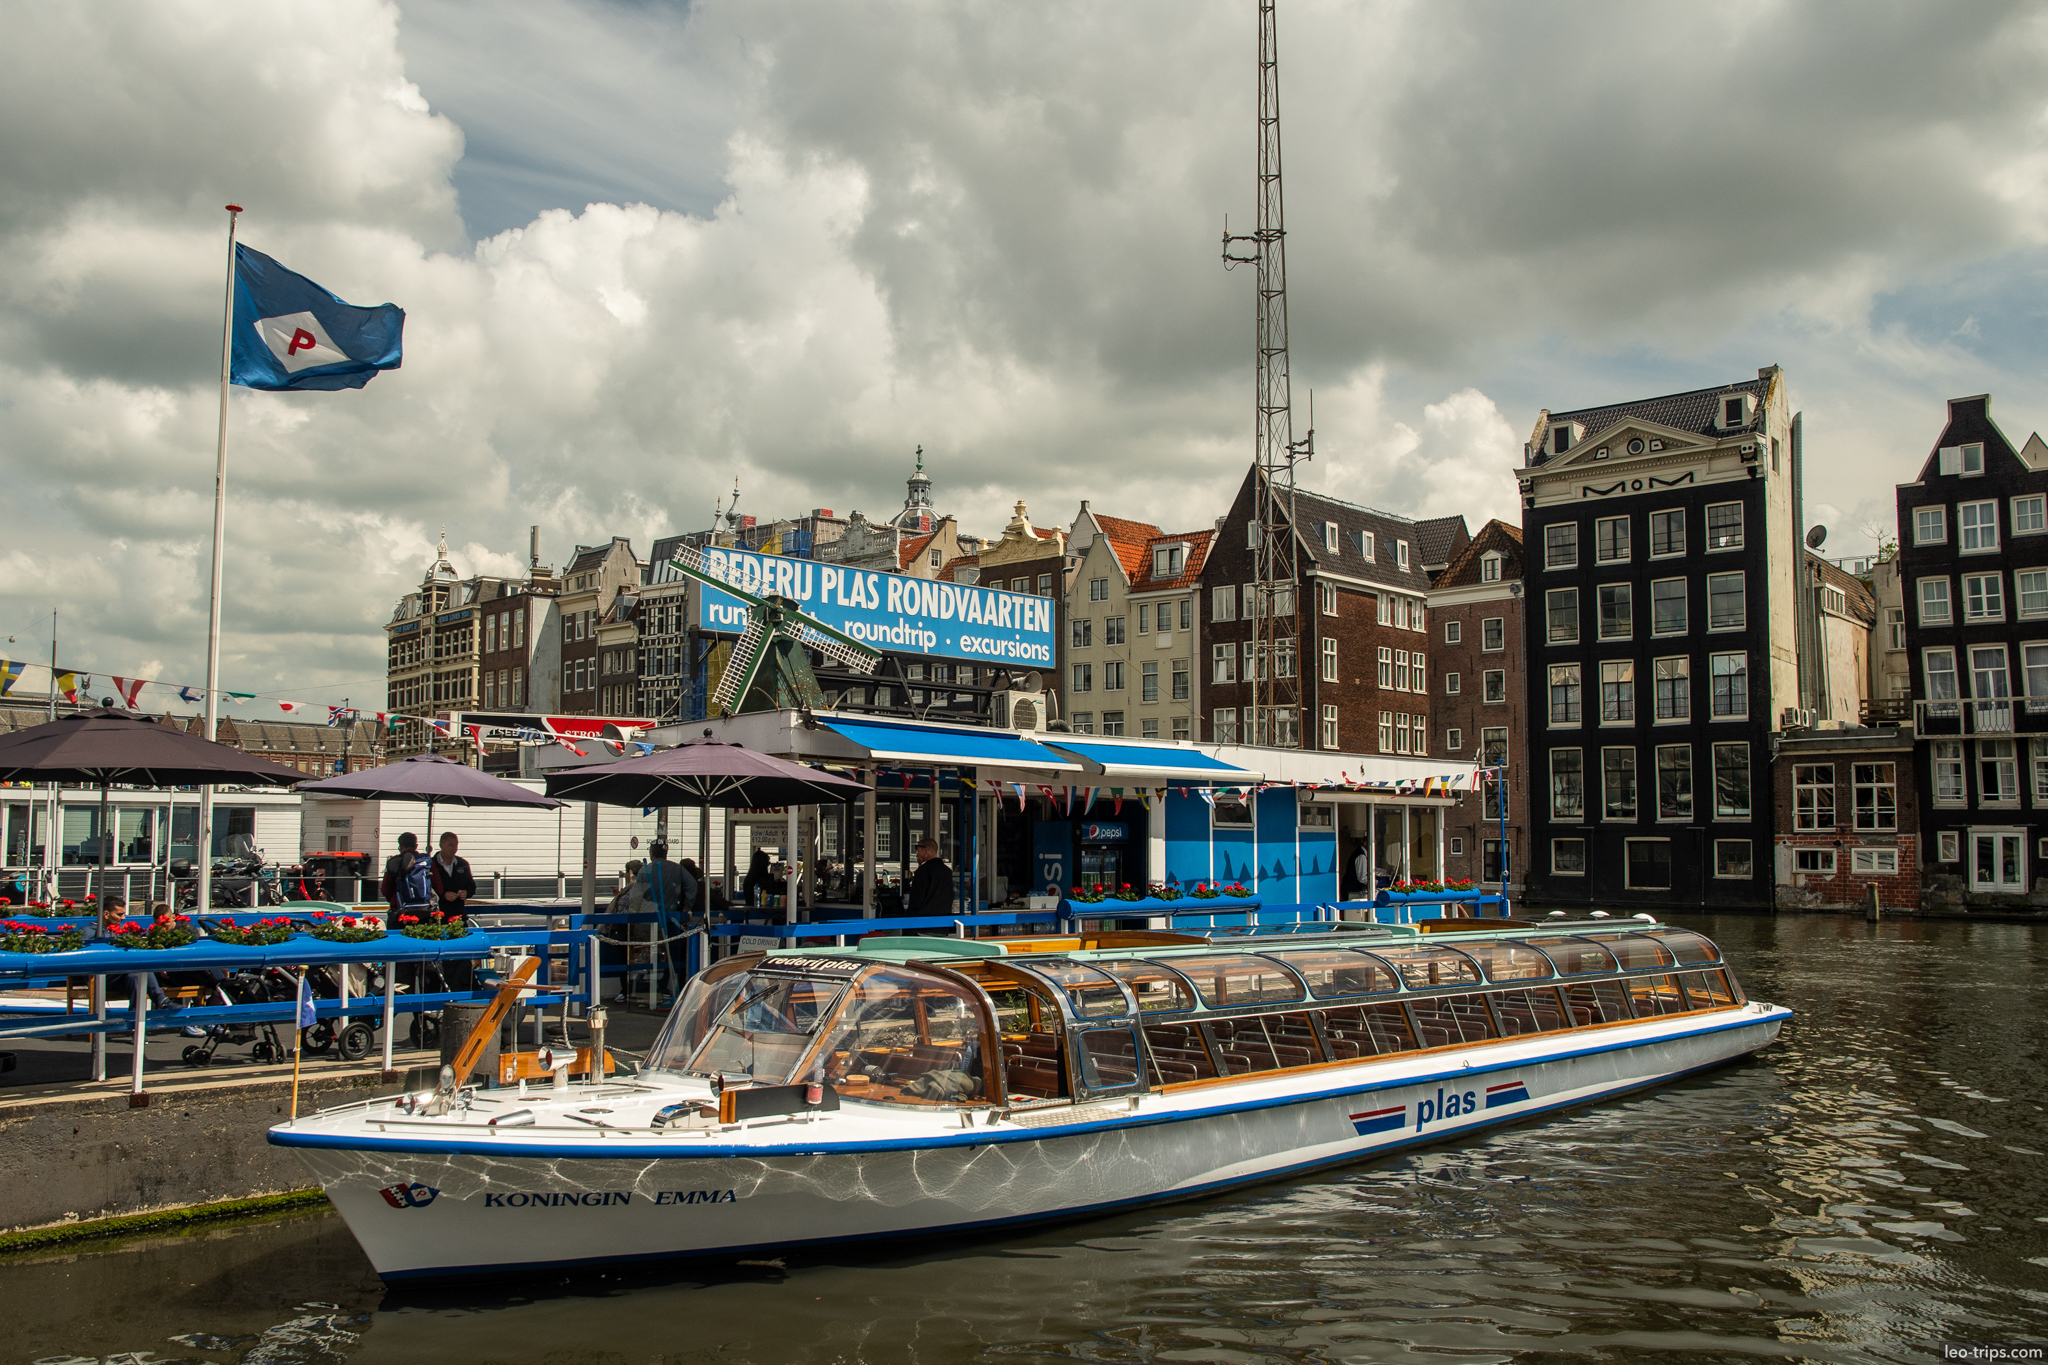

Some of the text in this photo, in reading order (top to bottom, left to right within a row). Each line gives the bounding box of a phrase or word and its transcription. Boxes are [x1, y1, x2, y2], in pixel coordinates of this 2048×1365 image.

[287, 327, 316, 356] P
[709, 549, 1050, 633] REDERIJ PLAS RONDVAARTEN
[844, 617, 937, 653] roundtrip
[959, 634, 1050, 662] excursions
[1101, 827, 1122, 839] pepsi
[741, 937, 778, 947] COLD DRINKS
[767, 957, 862, 971] rederij plas
[1416, 1088, 1476, 1133] plas
[484, 1189, 737, 1207] KONINGIN EMMA
